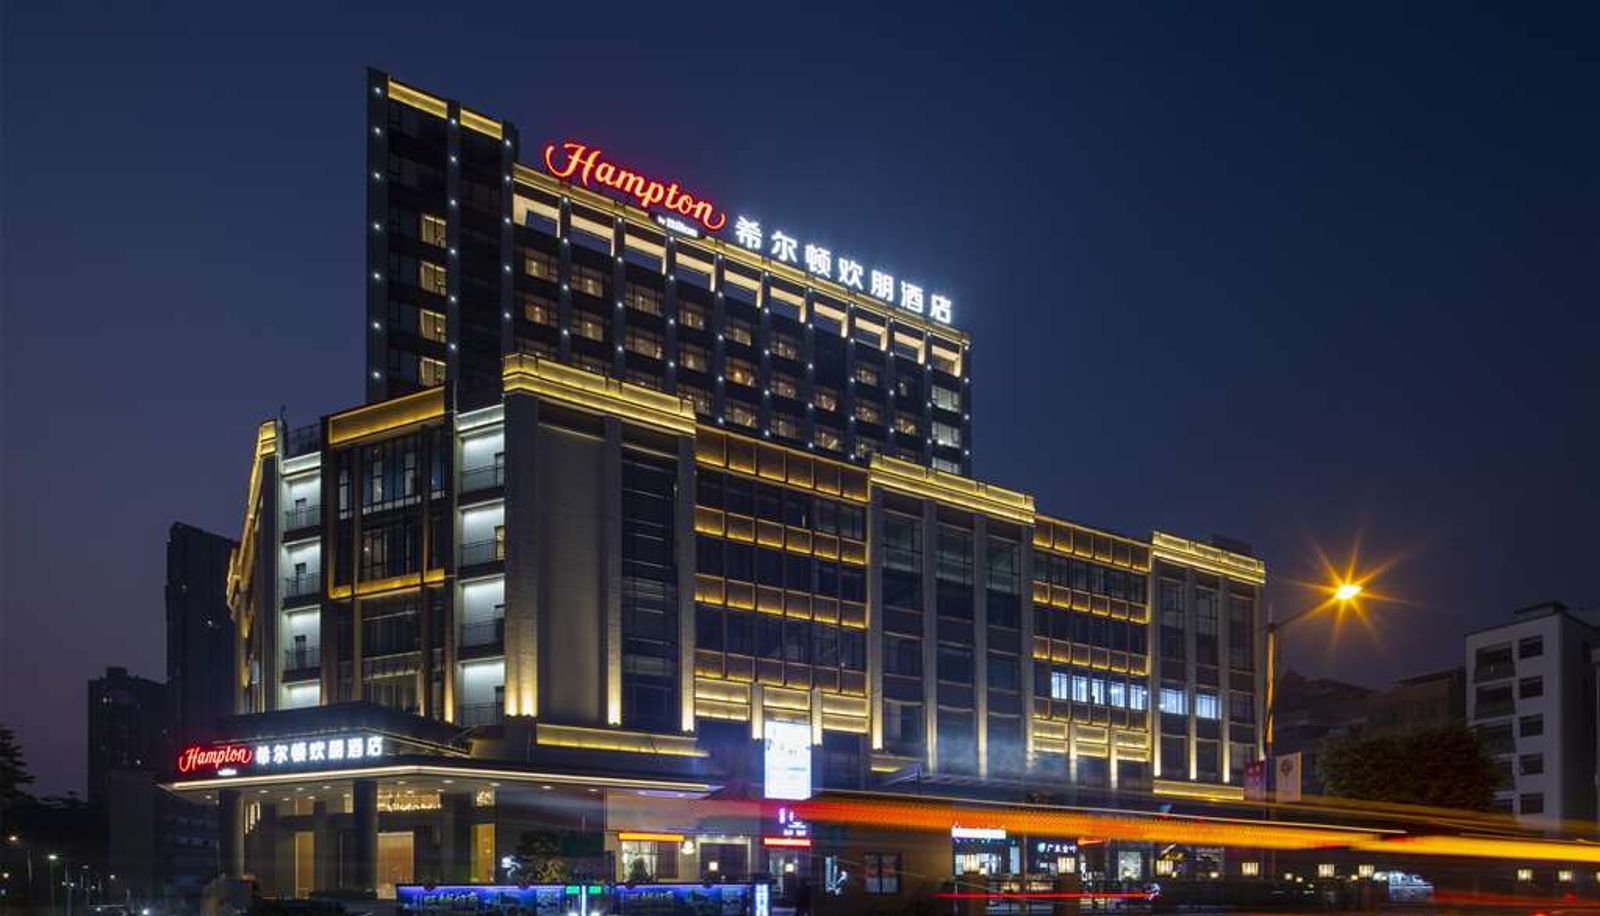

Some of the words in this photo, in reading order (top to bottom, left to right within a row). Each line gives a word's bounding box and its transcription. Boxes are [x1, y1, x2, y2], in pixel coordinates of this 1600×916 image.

[545, 143, 726, 230] Hampton
[735, 216, 952, 324] 希尔顿欢朋酒店
[179, 746, 252, 772] Hampton
[256, 736, 383, 764] 希尔顿欢朋酒店
